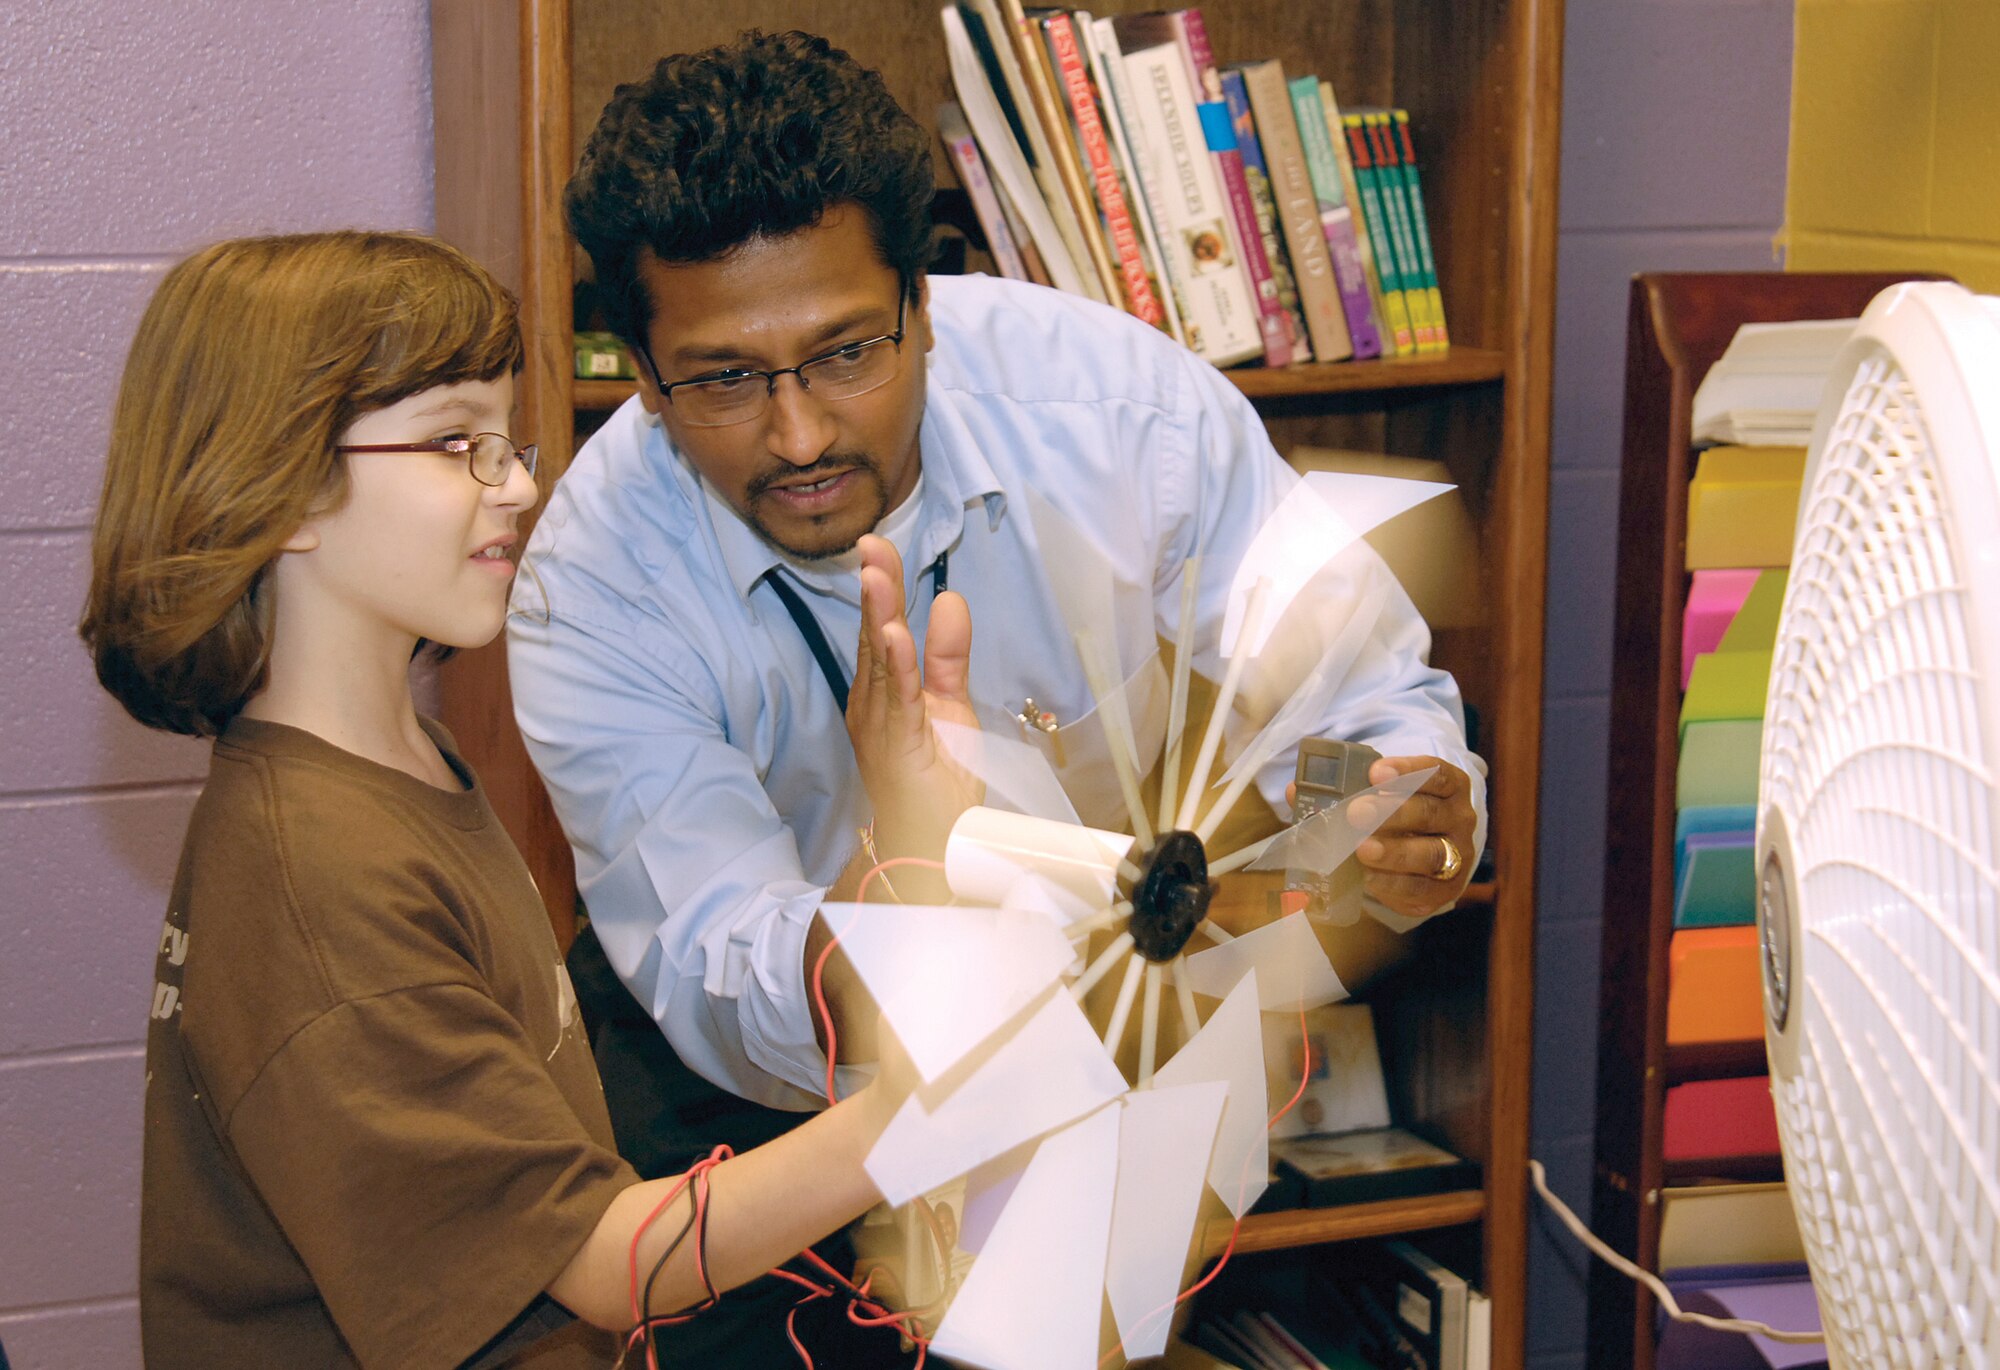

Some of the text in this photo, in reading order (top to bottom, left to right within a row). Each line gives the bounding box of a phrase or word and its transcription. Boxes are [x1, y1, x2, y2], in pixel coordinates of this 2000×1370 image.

[1050, 17, 1079, 62] BEST
[1064, 66, 1103, 147] RECIPES
[1152, 63, 1187, 152] SPLENDID
[1179, 158, 1203, 215] SOUPS
[1289, 198, 1326, 278] LAND
[1124, 258, 1160, 324] BOOKS
